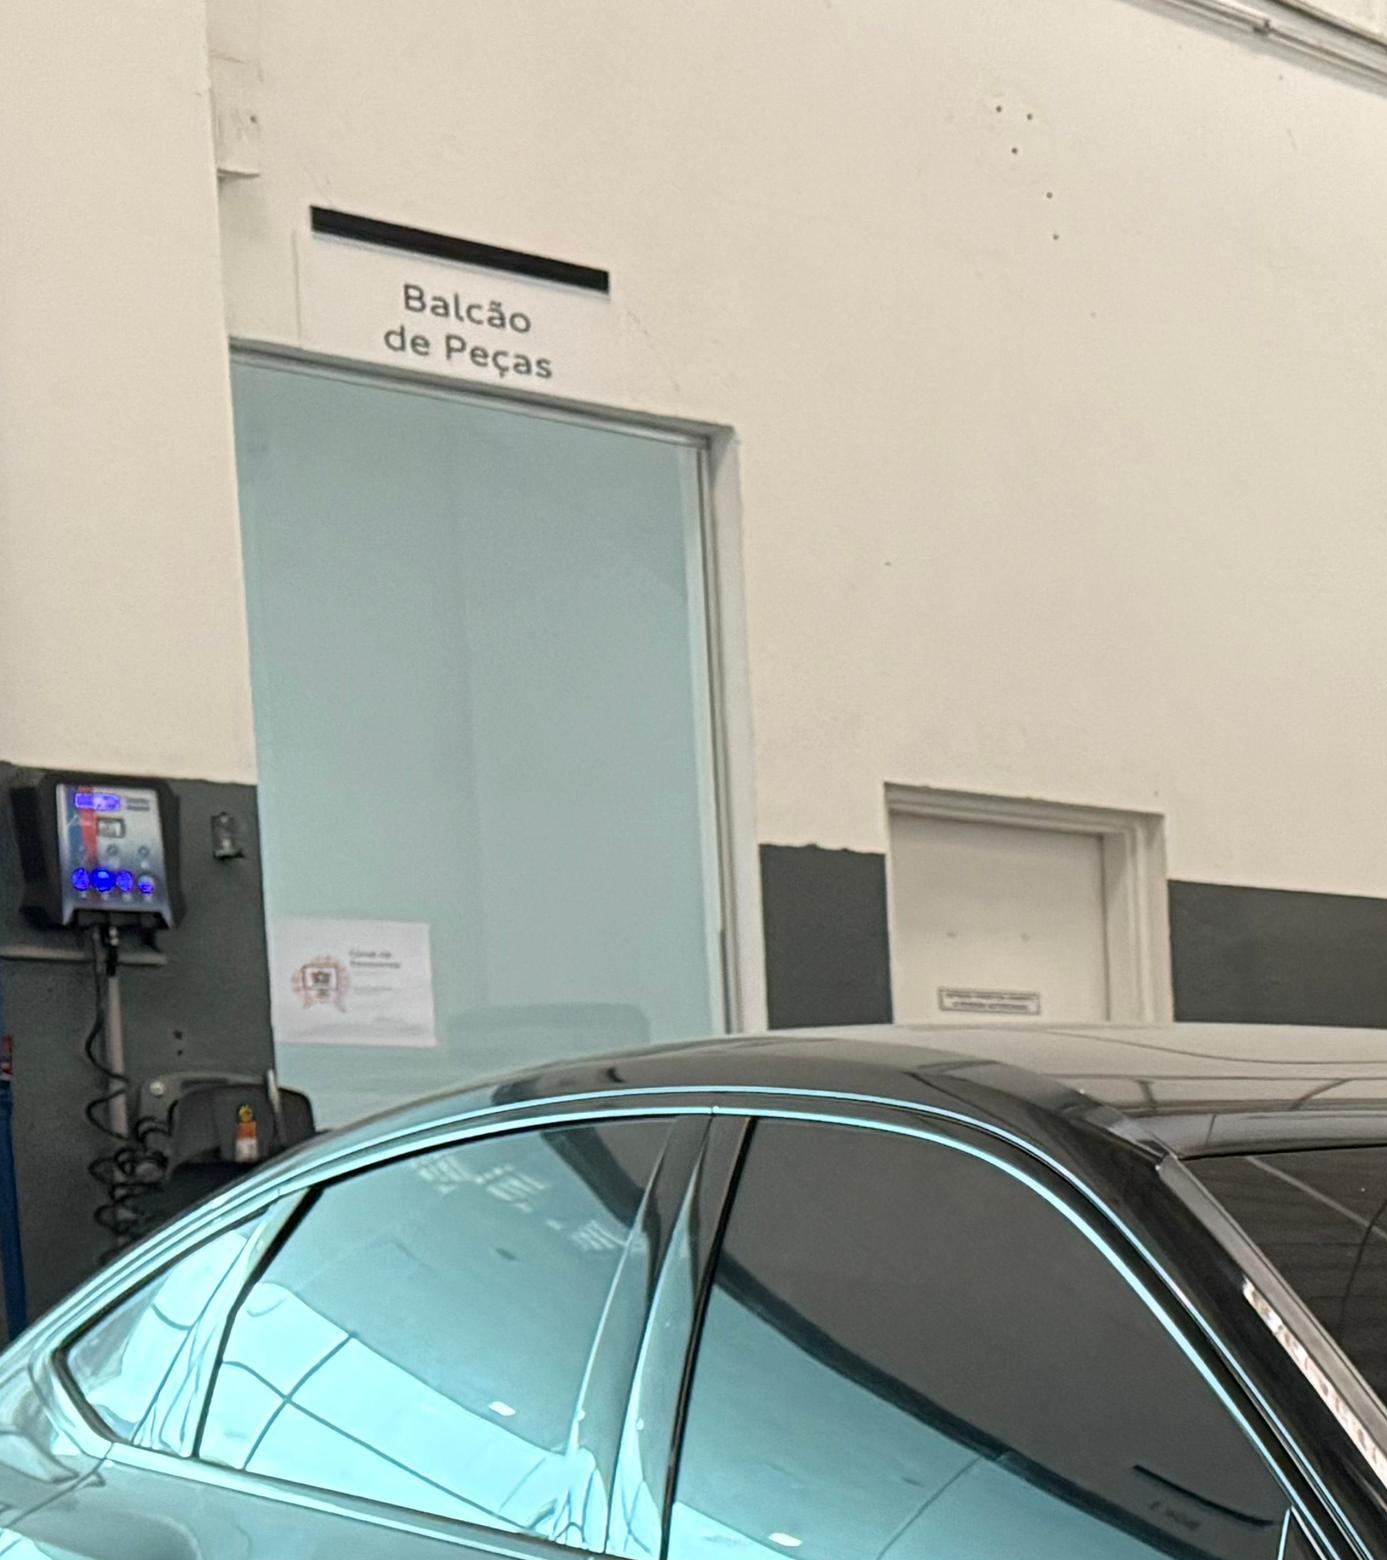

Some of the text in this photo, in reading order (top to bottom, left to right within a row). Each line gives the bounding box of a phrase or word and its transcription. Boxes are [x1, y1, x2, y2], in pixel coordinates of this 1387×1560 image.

[403, 283, 532, 334] Balcão
[383, 324, 553, 379] de Peças
